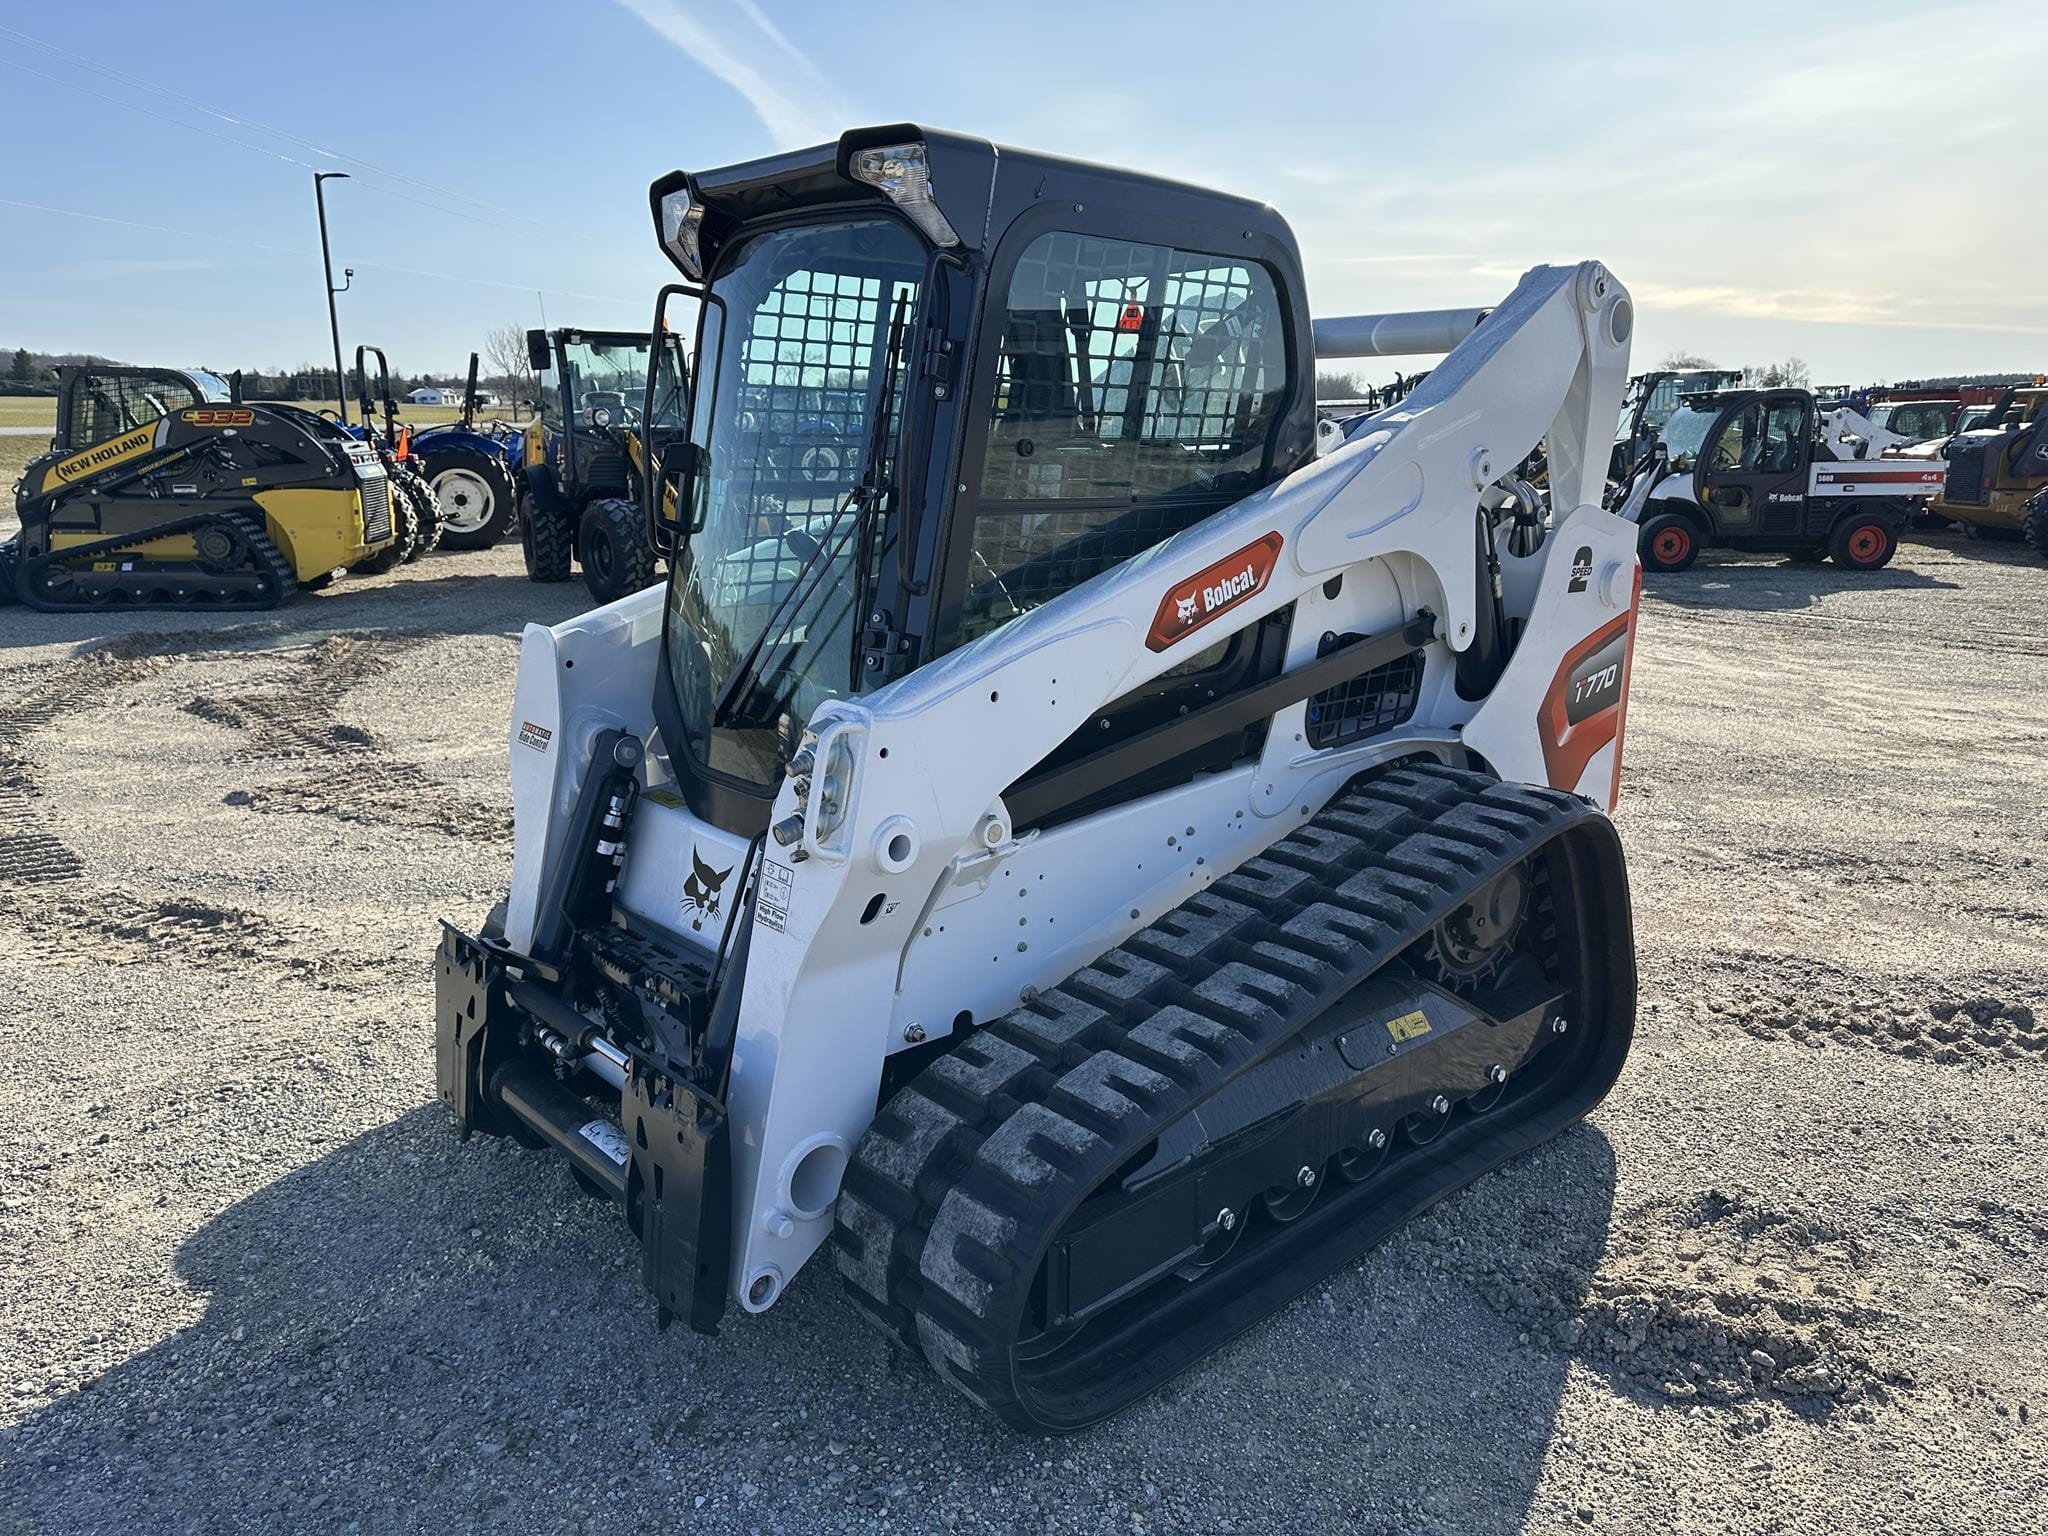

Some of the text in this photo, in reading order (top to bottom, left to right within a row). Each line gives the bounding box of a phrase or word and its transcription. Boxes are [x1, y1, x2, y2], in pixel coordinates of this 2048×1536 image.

[60, 457, 90, 477] NEW
[91, 433, 149, 465] HOLLAND
[1921, 474, 1938, 482] 4x4
[1779, 493, 1803, 502] Bobcat
[1571, 566, 1592, 577] SPEED
[1203, 564, 1255, 613] Bobcat
[1575, 663, 1618, 704] T770
[522, 722, 551, 740] AUTOMATIC
[518, 730, 549, 751] Ride Control
[757, 912, 784, 930] Hydraulics
[759, 904, 785, 922] High Flow
